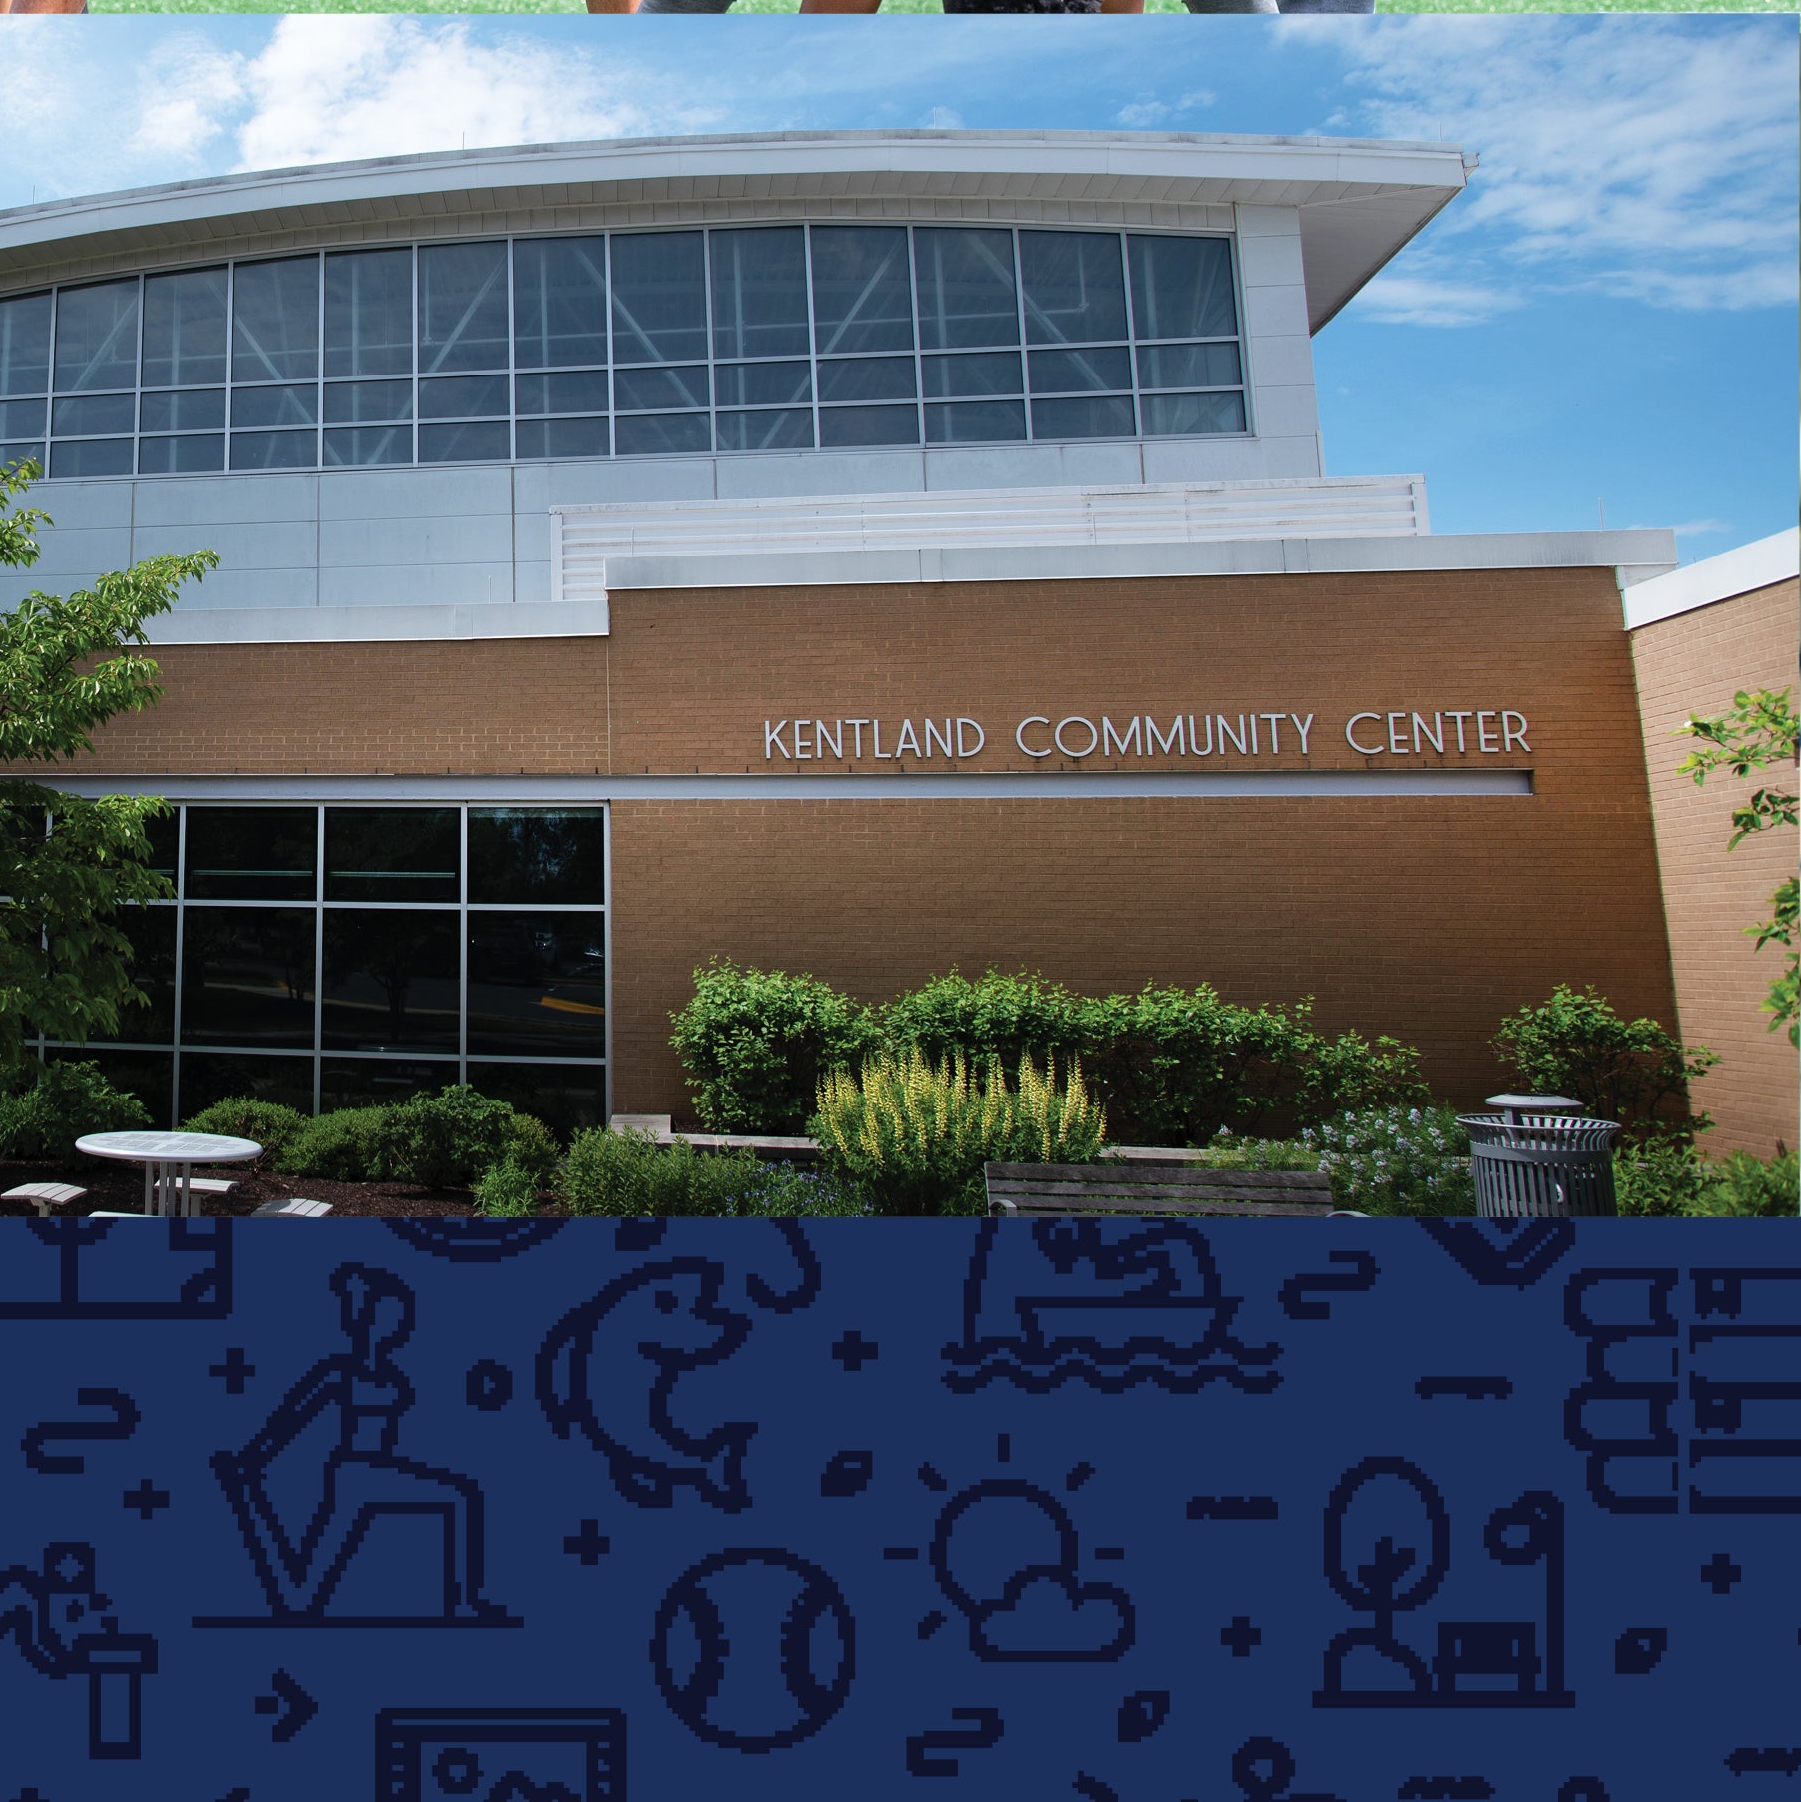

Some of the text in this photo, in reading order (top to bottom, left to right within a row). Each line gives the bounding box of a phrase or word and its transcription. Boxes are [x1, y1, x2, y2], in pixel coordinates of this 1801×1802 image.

[763, 710, 1532, 760] KENTLAND COMMUNITY CENTER
